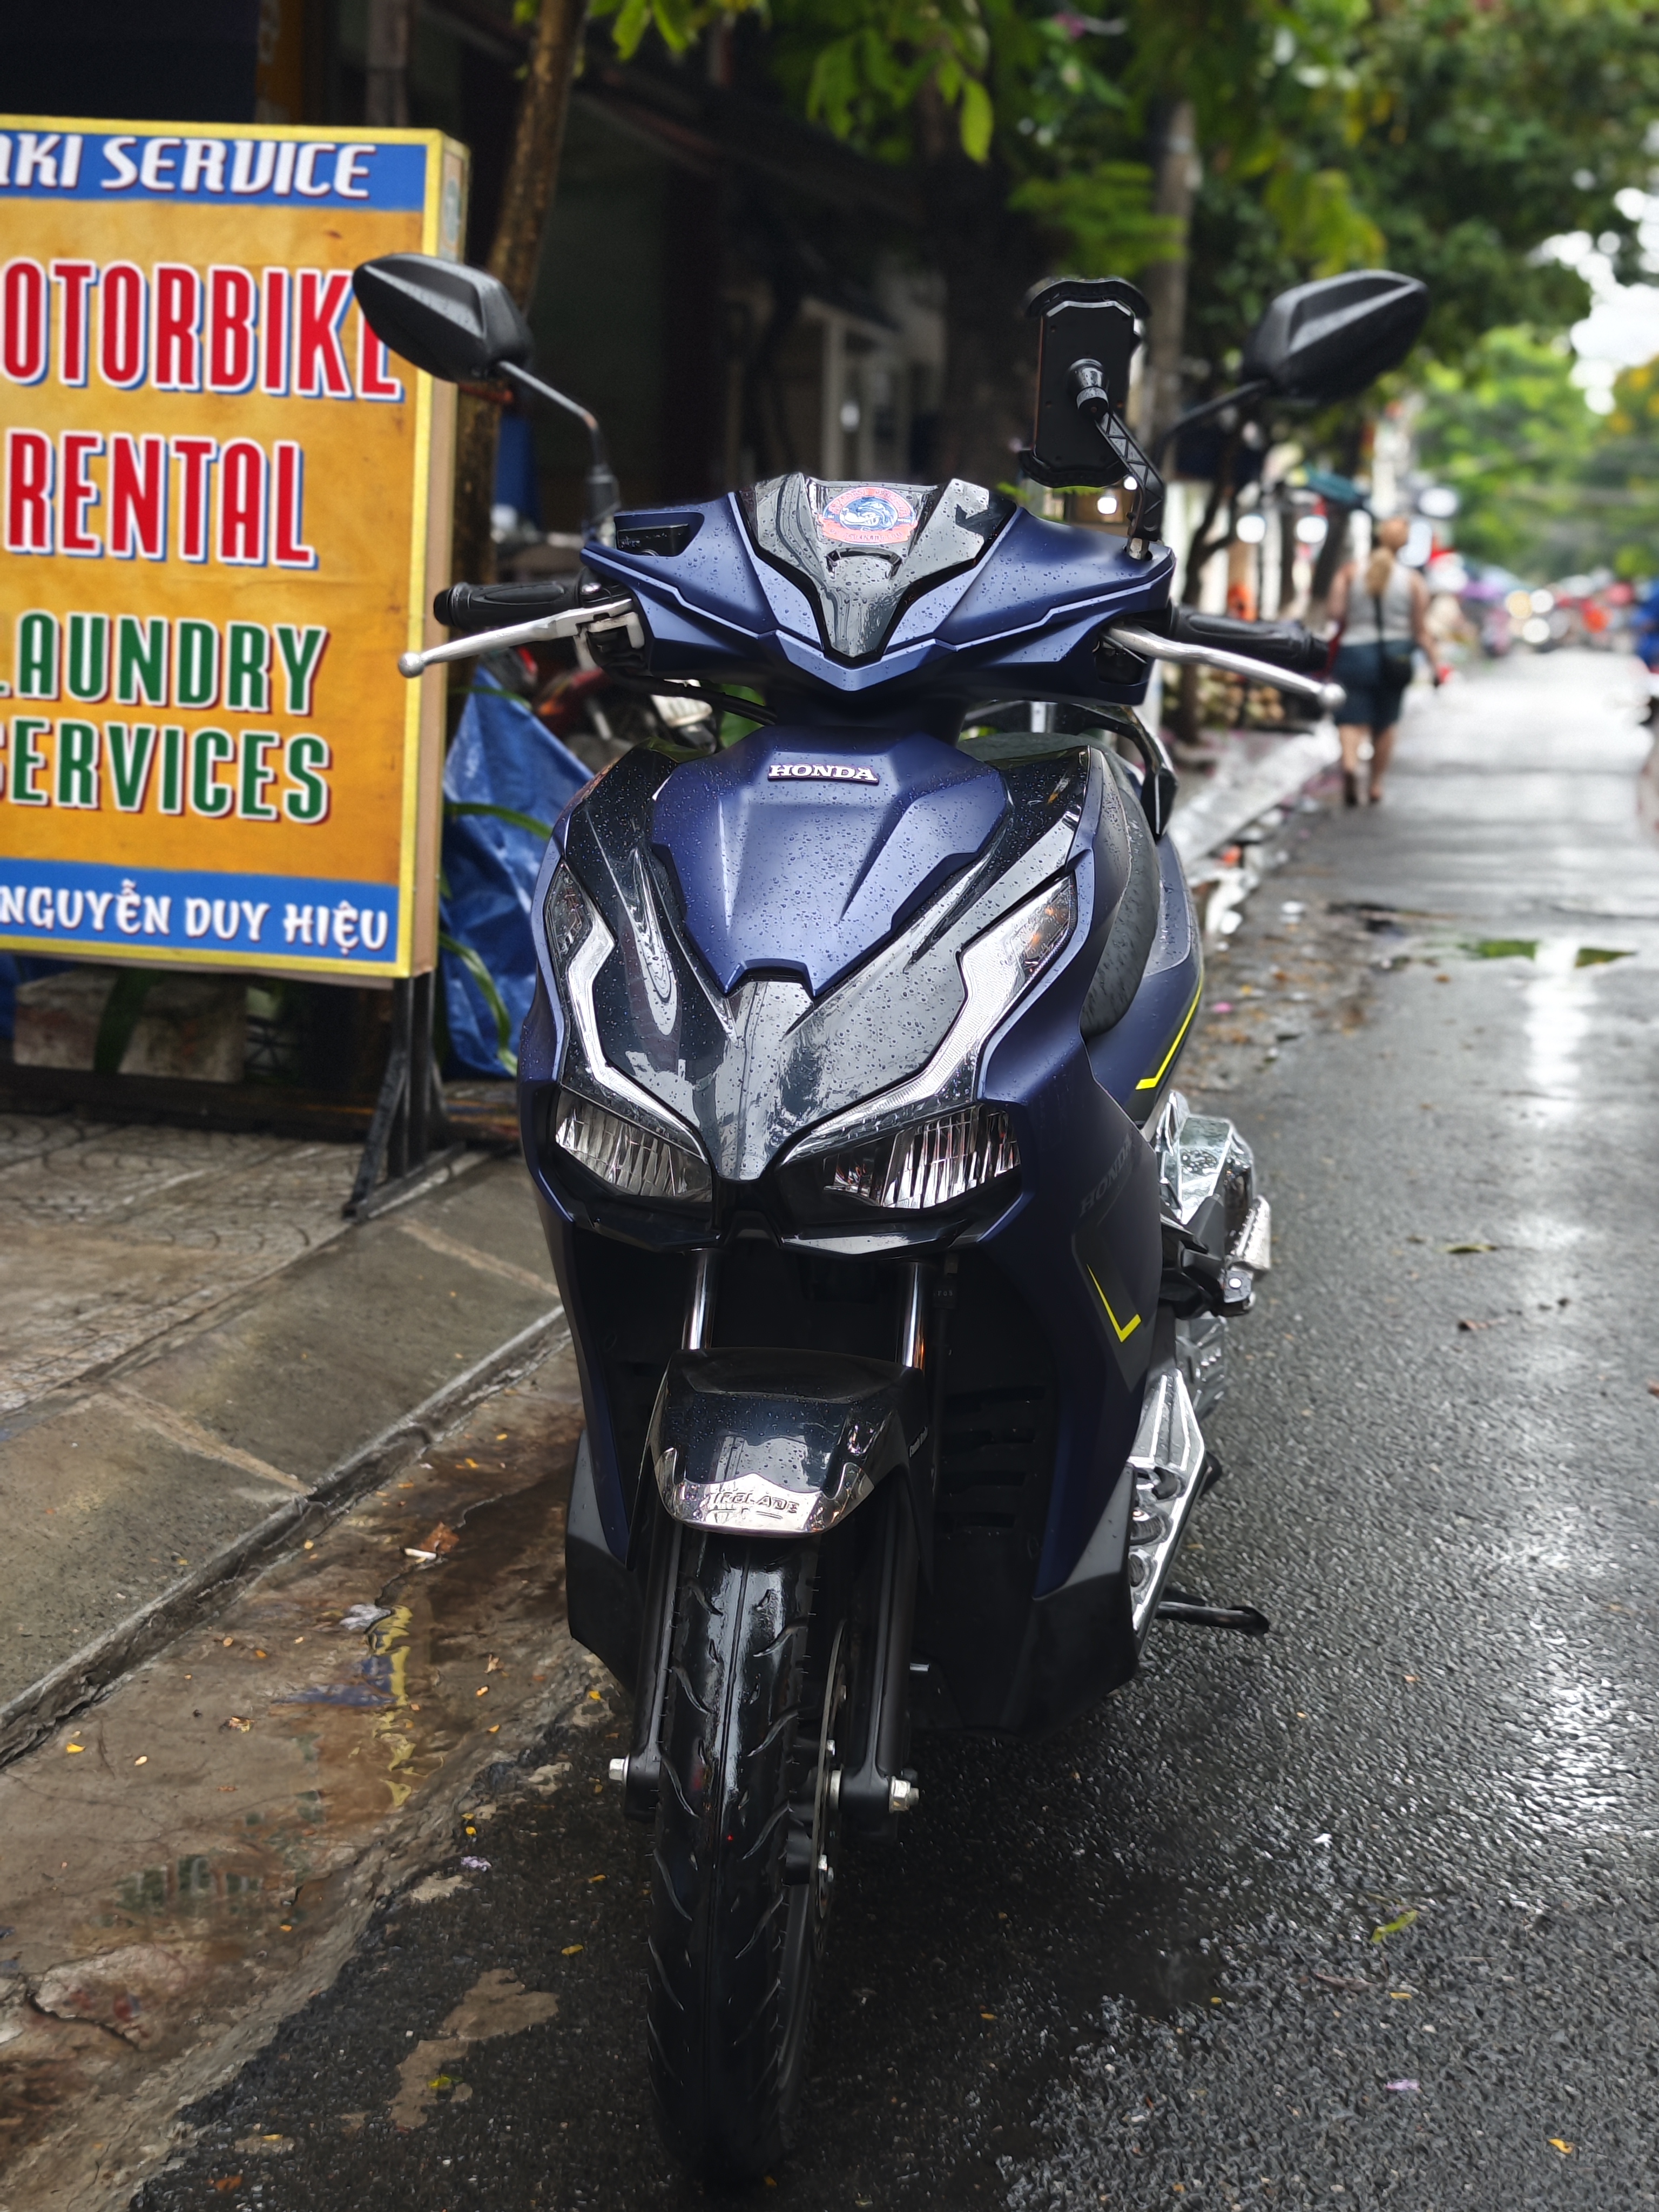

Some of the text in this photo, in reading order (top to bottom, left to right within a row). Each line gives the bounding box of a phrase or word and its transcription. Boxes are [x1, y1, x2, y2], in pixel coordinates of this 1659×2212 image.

[100, 136, 377, 199] SERVICE
[5, 428, 317, 568] RENTAL
[0, 610, 328, 716] AUNDRY
[0, 716, 330, 824] ERVICES
[768, 764, 878, 781] HONDA
[185, 897, 271, 942] DUY
[282, 900, 389, 956] HIỆU
